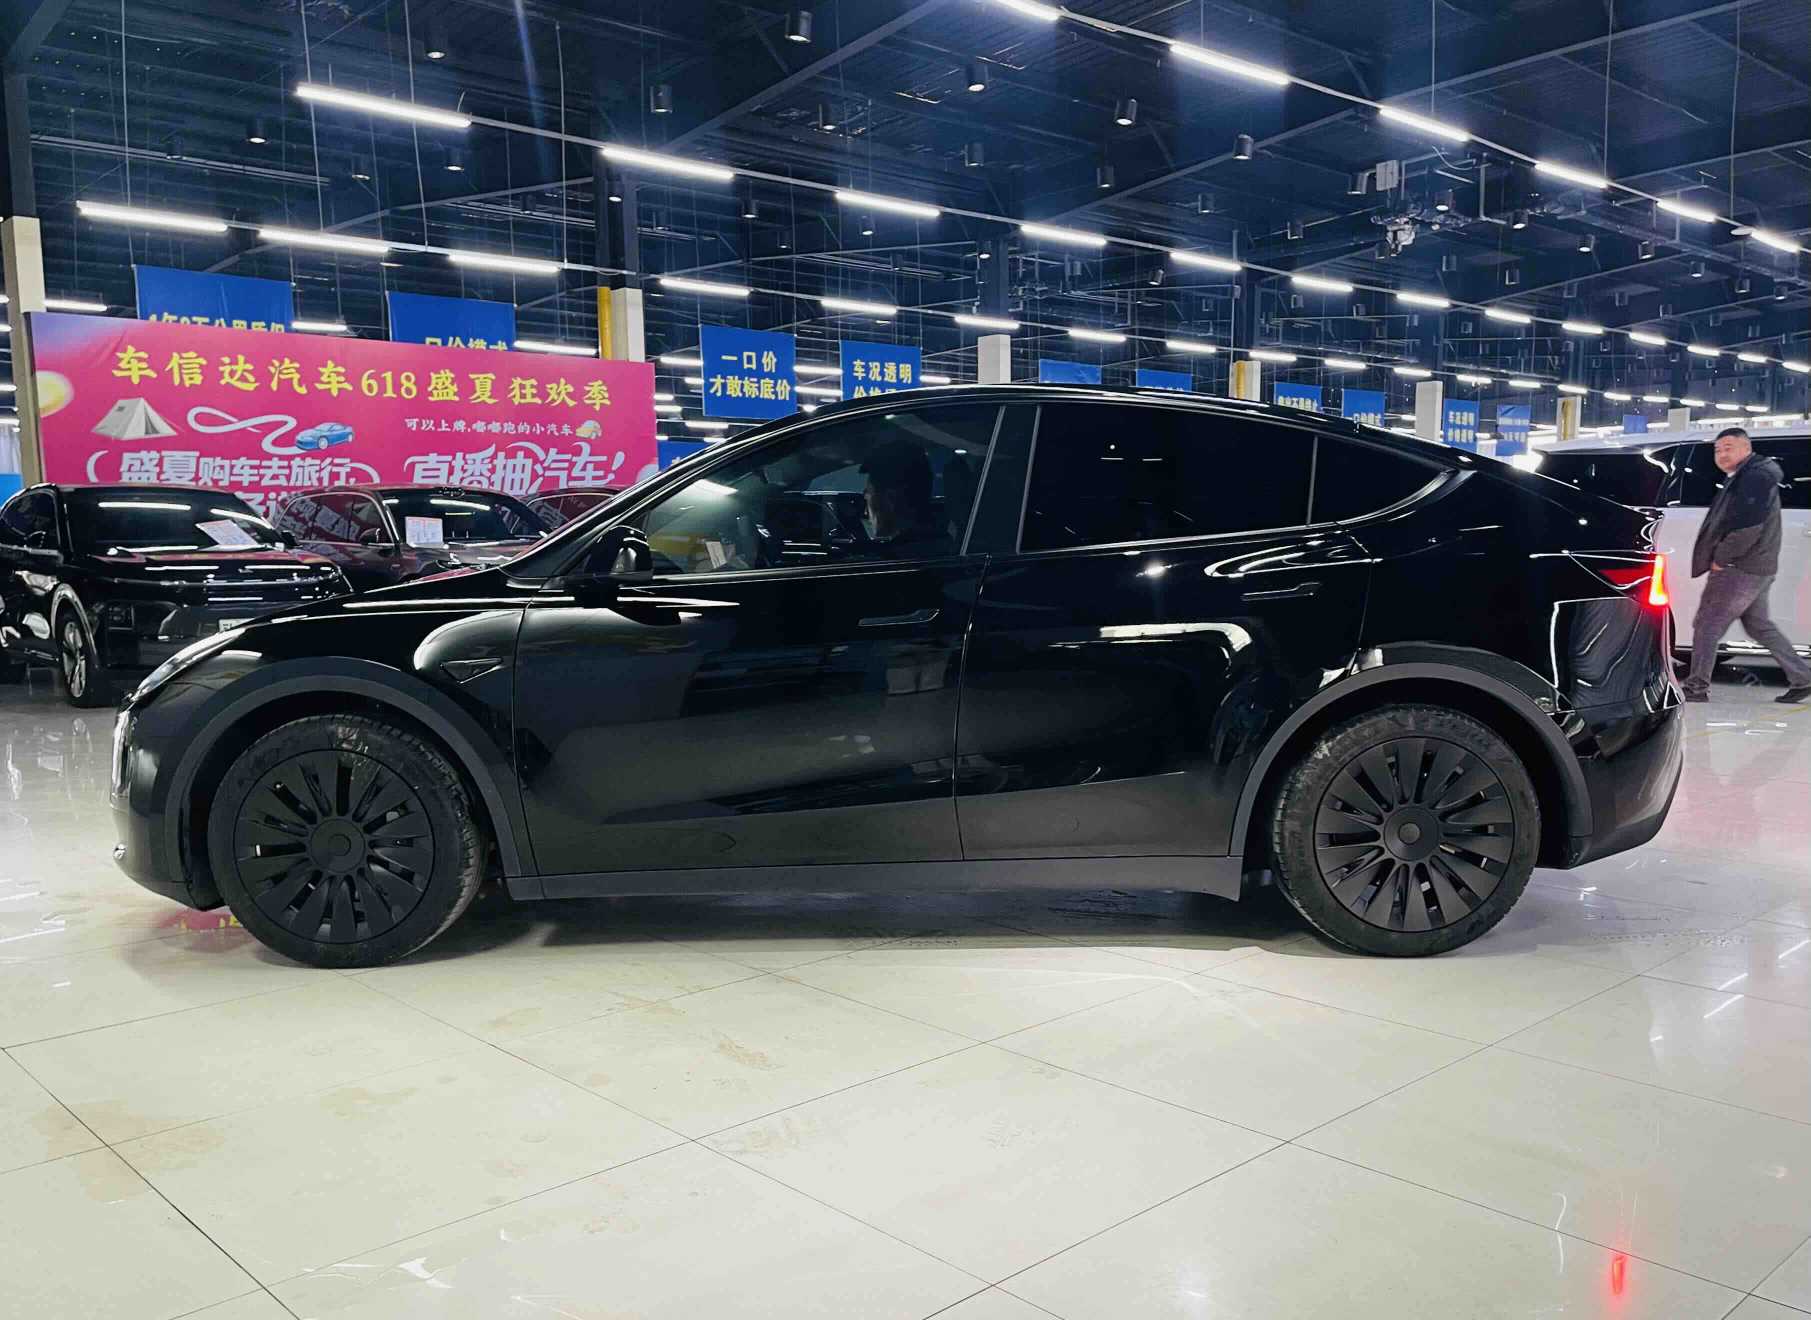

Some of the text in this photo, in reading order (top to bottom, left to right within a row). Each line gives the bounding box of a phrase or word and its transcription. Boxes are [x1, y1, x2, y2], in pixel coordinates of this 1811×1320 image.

[720, 350, 777, 373] 一口价
[852, 359, 912, 384] 车况透明
[112, 345, 612, 411] 车信达汽车618盛夏狂欢季
[709, 375, 791, 401] 才敢标底价
